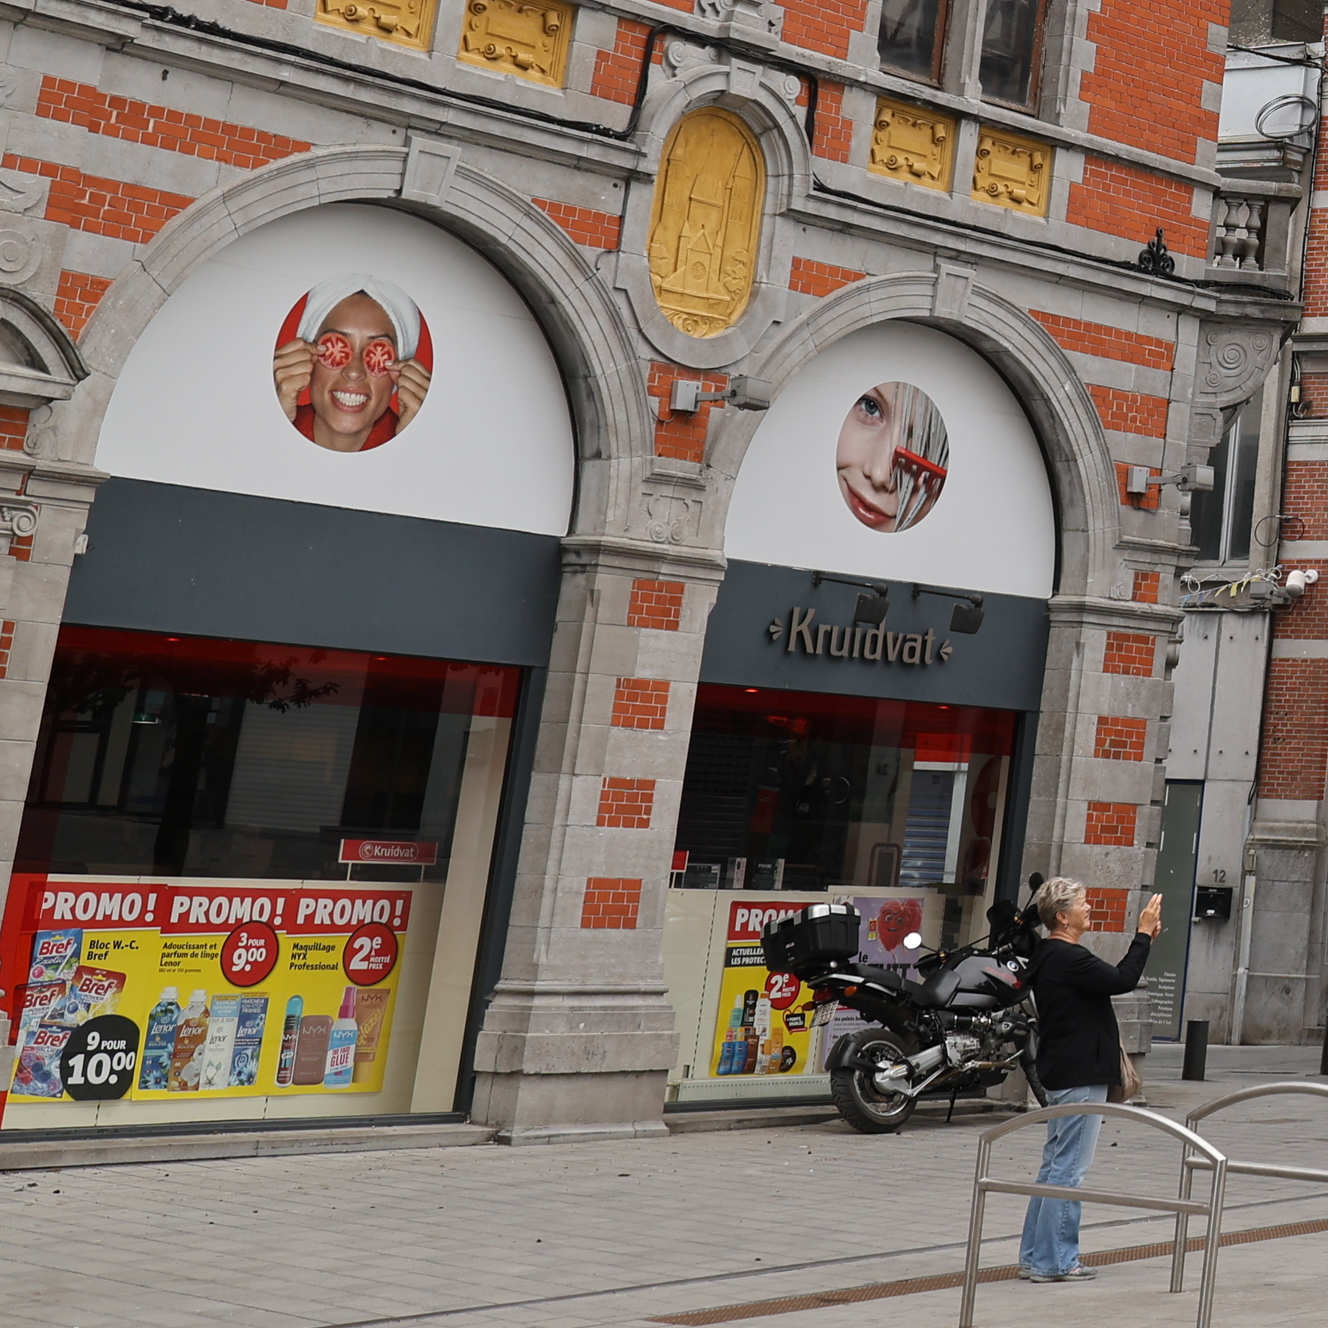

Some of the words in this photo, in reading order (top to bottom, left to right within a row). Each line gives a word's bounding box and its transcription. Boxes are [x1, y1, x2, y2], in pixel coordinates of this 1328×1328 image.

[787, 607, 936, 664] Kruidvat
[373, 845, 414, 857] Kruidvat
[1213, 869, 1226, 883] 12
[41, 891, 157, 922] PROMO!
[170, 896, 286, 925] PROMO!
[296, 898, 404, 927] PROMO!
[89, 940, 110, 950] Bloc
[112, 940, 139, 950] W.-C.
[162, 942, 208, 950] Adoucissant
[238, 932, 248, 946] 3
[38, 938, 73, 956] Bref
[292, 942, 336, 953] Maquillage
[87, 951, 109, 961] Bref
[161, 951, 189, 960] parfum
[190, 951, 199, 959] de
[200, 951, 219, 960] linge
[290, 952, 307, 961] NYX
[741, 956, 767, 965] PROTEC
[289, 962, 338, 971] Professional
[79, 977, 115, 997] Bref
[23, 989, 58, 1008] Bref
[34, 1030, 71, 1047] Bref
[86, 1031, 100, 1050] 9
[101, 1040, 126, 1050] POUR
[330, 1053, 350, 1068] GLUE
